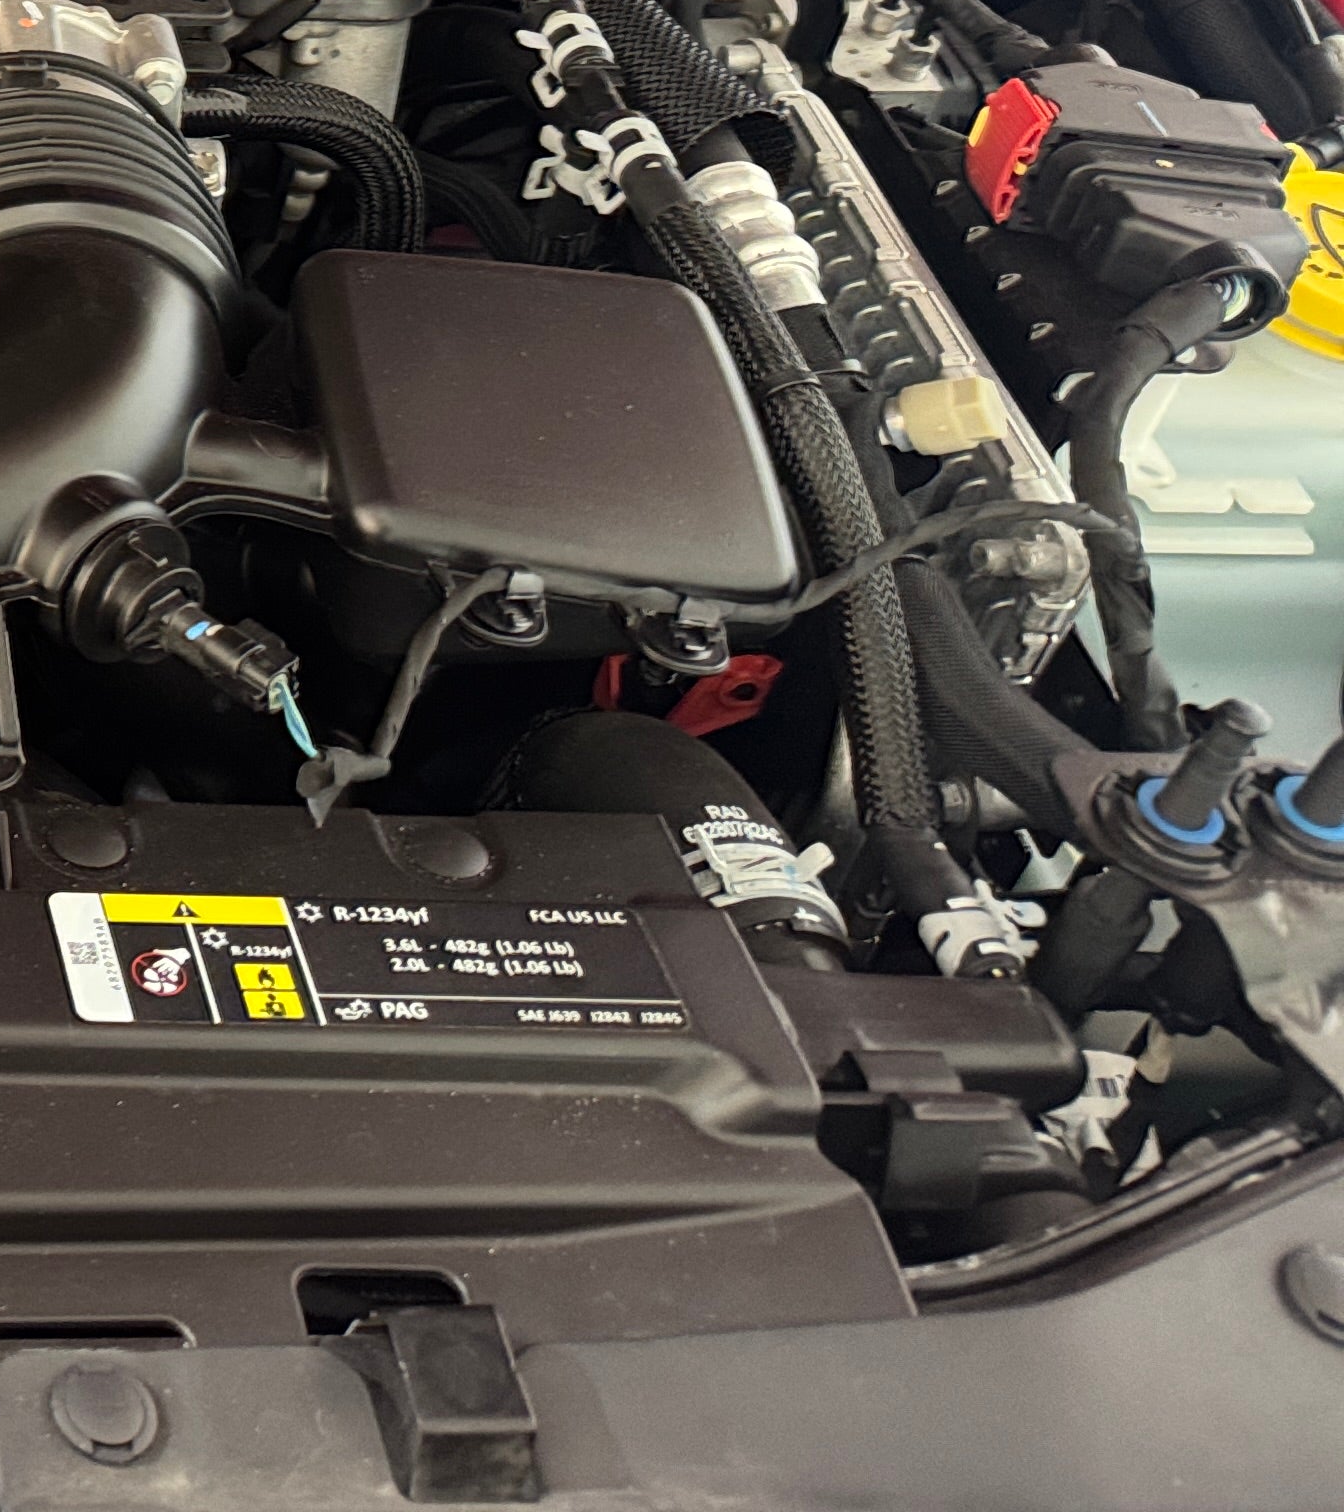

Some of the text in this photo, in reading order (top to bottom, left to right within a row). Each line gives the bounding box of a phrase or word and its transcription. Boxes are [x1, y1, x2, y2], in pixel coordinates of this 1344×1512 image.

[704, 804, 749, 820] RAD
[332, 905, 430, 926] R-1234yf
[529, 909, 628, 925] FCA US LLC
[382, 938, 423, 953] 3.6L
[444, 939, 491, 956] 482g
[495, 940, 543, 956] (1.06
[390, 957, 431, 972] 2.0L
[452, 959, 500, 976] 482g
[504, 959, 552, 976] (1.06
[380, 1001, 429, 1021] PAG
[517, 1009, 546, 1022] SAE
